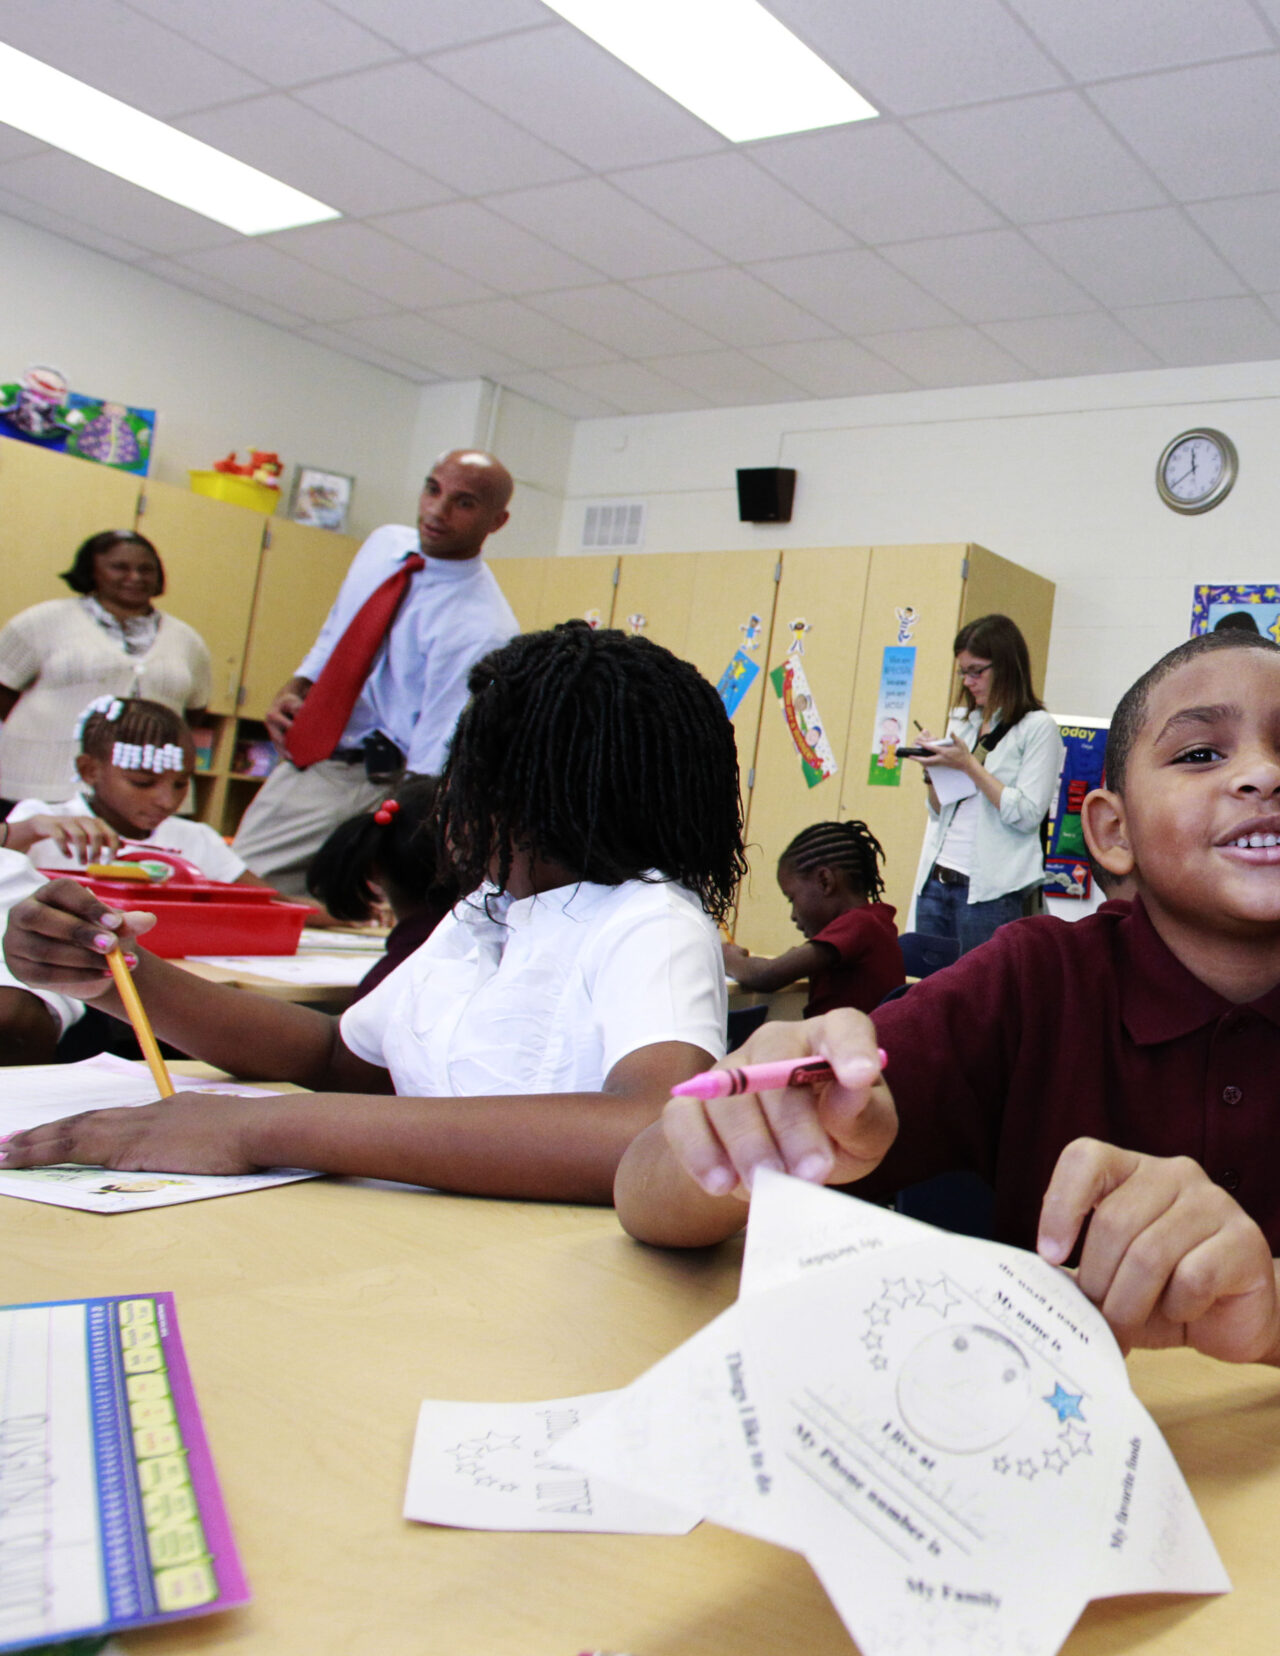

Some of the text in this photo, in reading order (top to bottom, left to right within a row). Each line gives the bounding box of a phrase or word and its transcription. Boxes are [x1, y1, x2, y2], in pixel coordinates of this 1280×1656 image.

[1016, 1311, 1050, 1340] name
[1051, 1339, 1062, 1352] is
[725, 1351, 747, 1403] Things
[742, 1417, 760, 1447] like
[892, 1429, 918, 1455] live
[920, 1455, 936, 1471] at
[796, 1423, 942, 1556] My Phone number is
[1109, 1436, 1142, 1554] My favorite foods
[905, 1576, 1002, 1614] My Family
